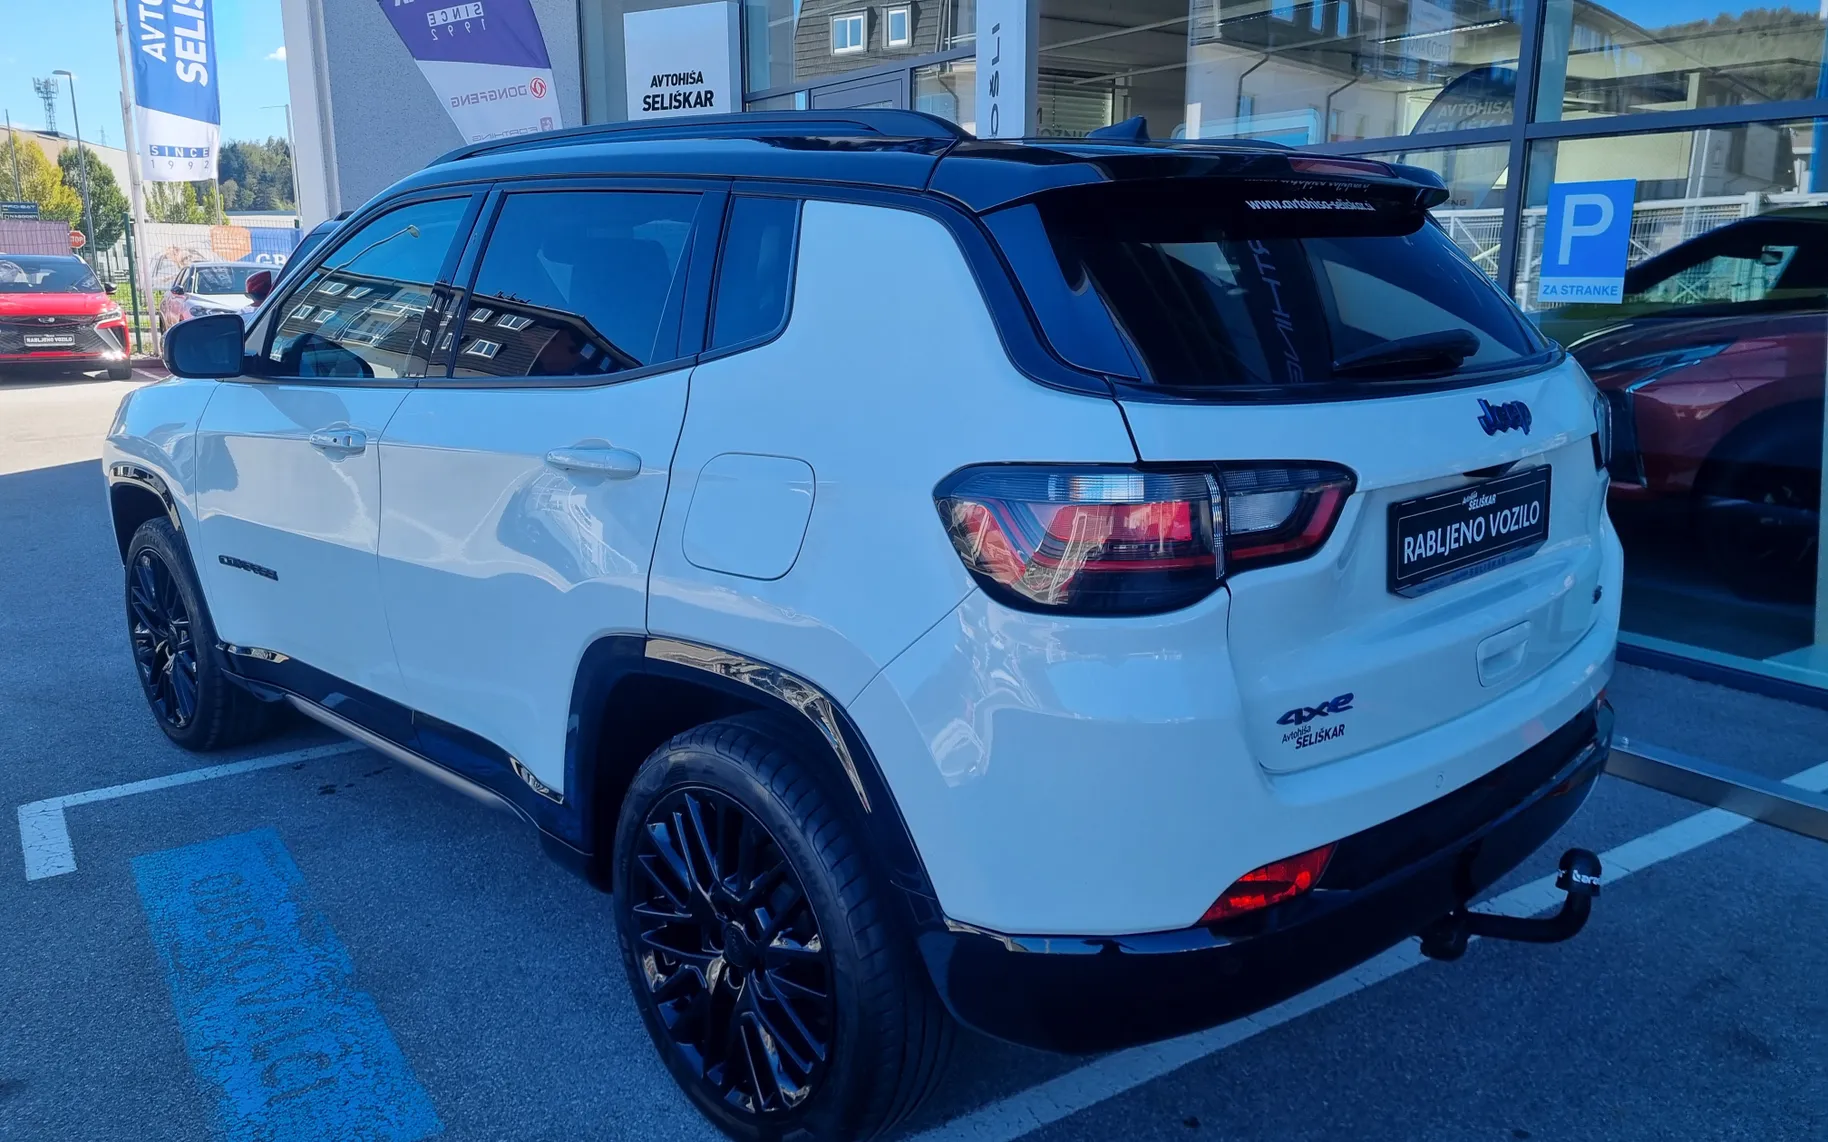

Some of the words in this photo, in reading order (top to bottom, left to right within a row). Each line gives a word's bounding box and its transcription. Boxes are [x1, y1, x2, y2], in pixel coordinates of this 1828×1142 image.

[650, 70, 704, 88] AVTOHIŠA
[642, 89, 714, 112] SELIŠKAR
[151, 145, 209, 157] SINCE
[151, 159, 210, 170] 1992
[1558, 193, 1614, 265] P
[1542, 284, 1558, 295] ZA
[1560, 285, 1618, 296] STRANKE
[1477, 398, 1533, 436] Jeep
[1404, 516, 1486, 565] RABLJENO
[1489, 500, 1541, 537] VOZILO
[1276, 692, 1354, 725] 4xe
[1281, 725, 1312, 744] Avtohiša
[1295, 723, 1346, 750] SELIŠKAR
